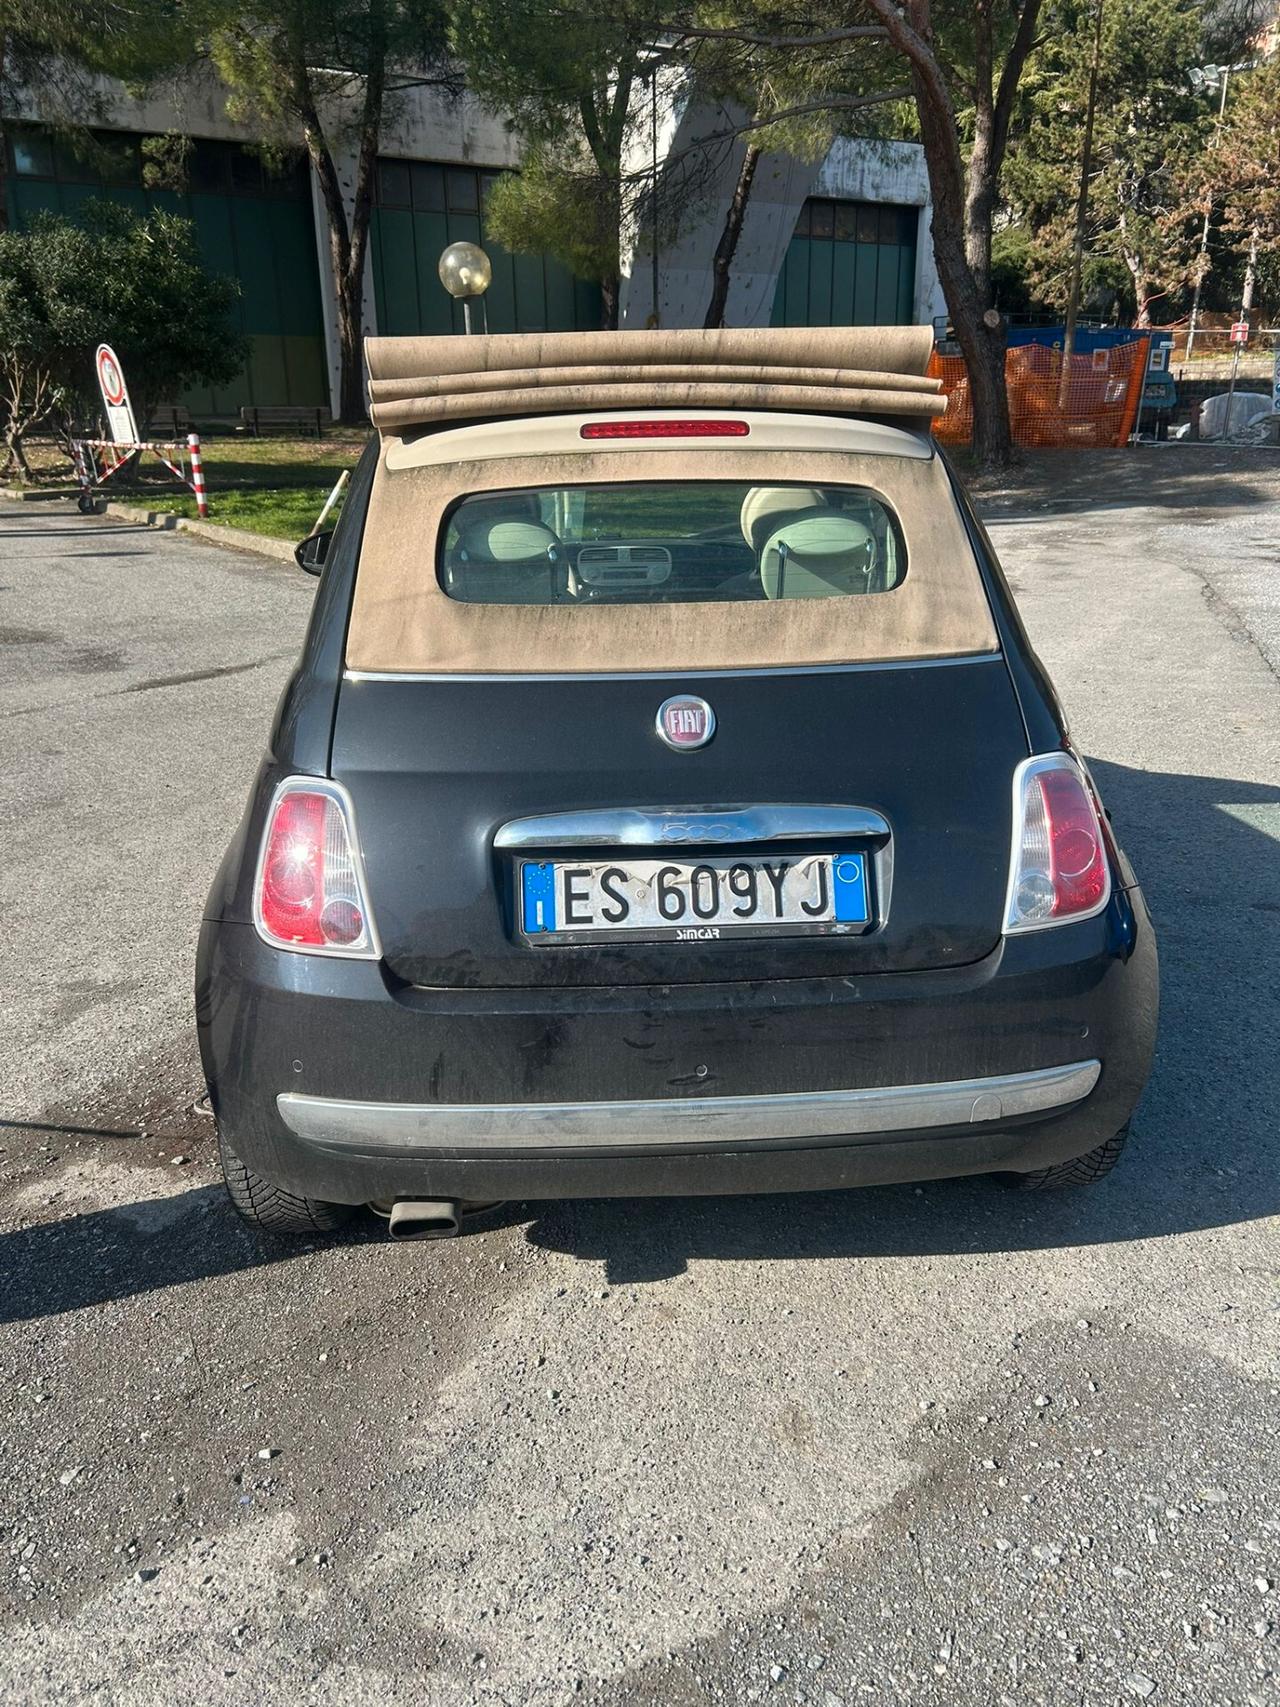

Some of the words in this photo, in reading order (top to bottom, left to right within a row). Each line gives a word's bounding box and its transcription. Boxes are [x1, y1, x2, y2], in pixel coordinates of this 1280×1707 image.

[670, 709, 703, 734] FIAT
[662, 821, 730, 842] 500
[564, 866, 631, 926] ES
[656, 860, 829, 922] 609YJ
[536, 900, 544, 926] I
